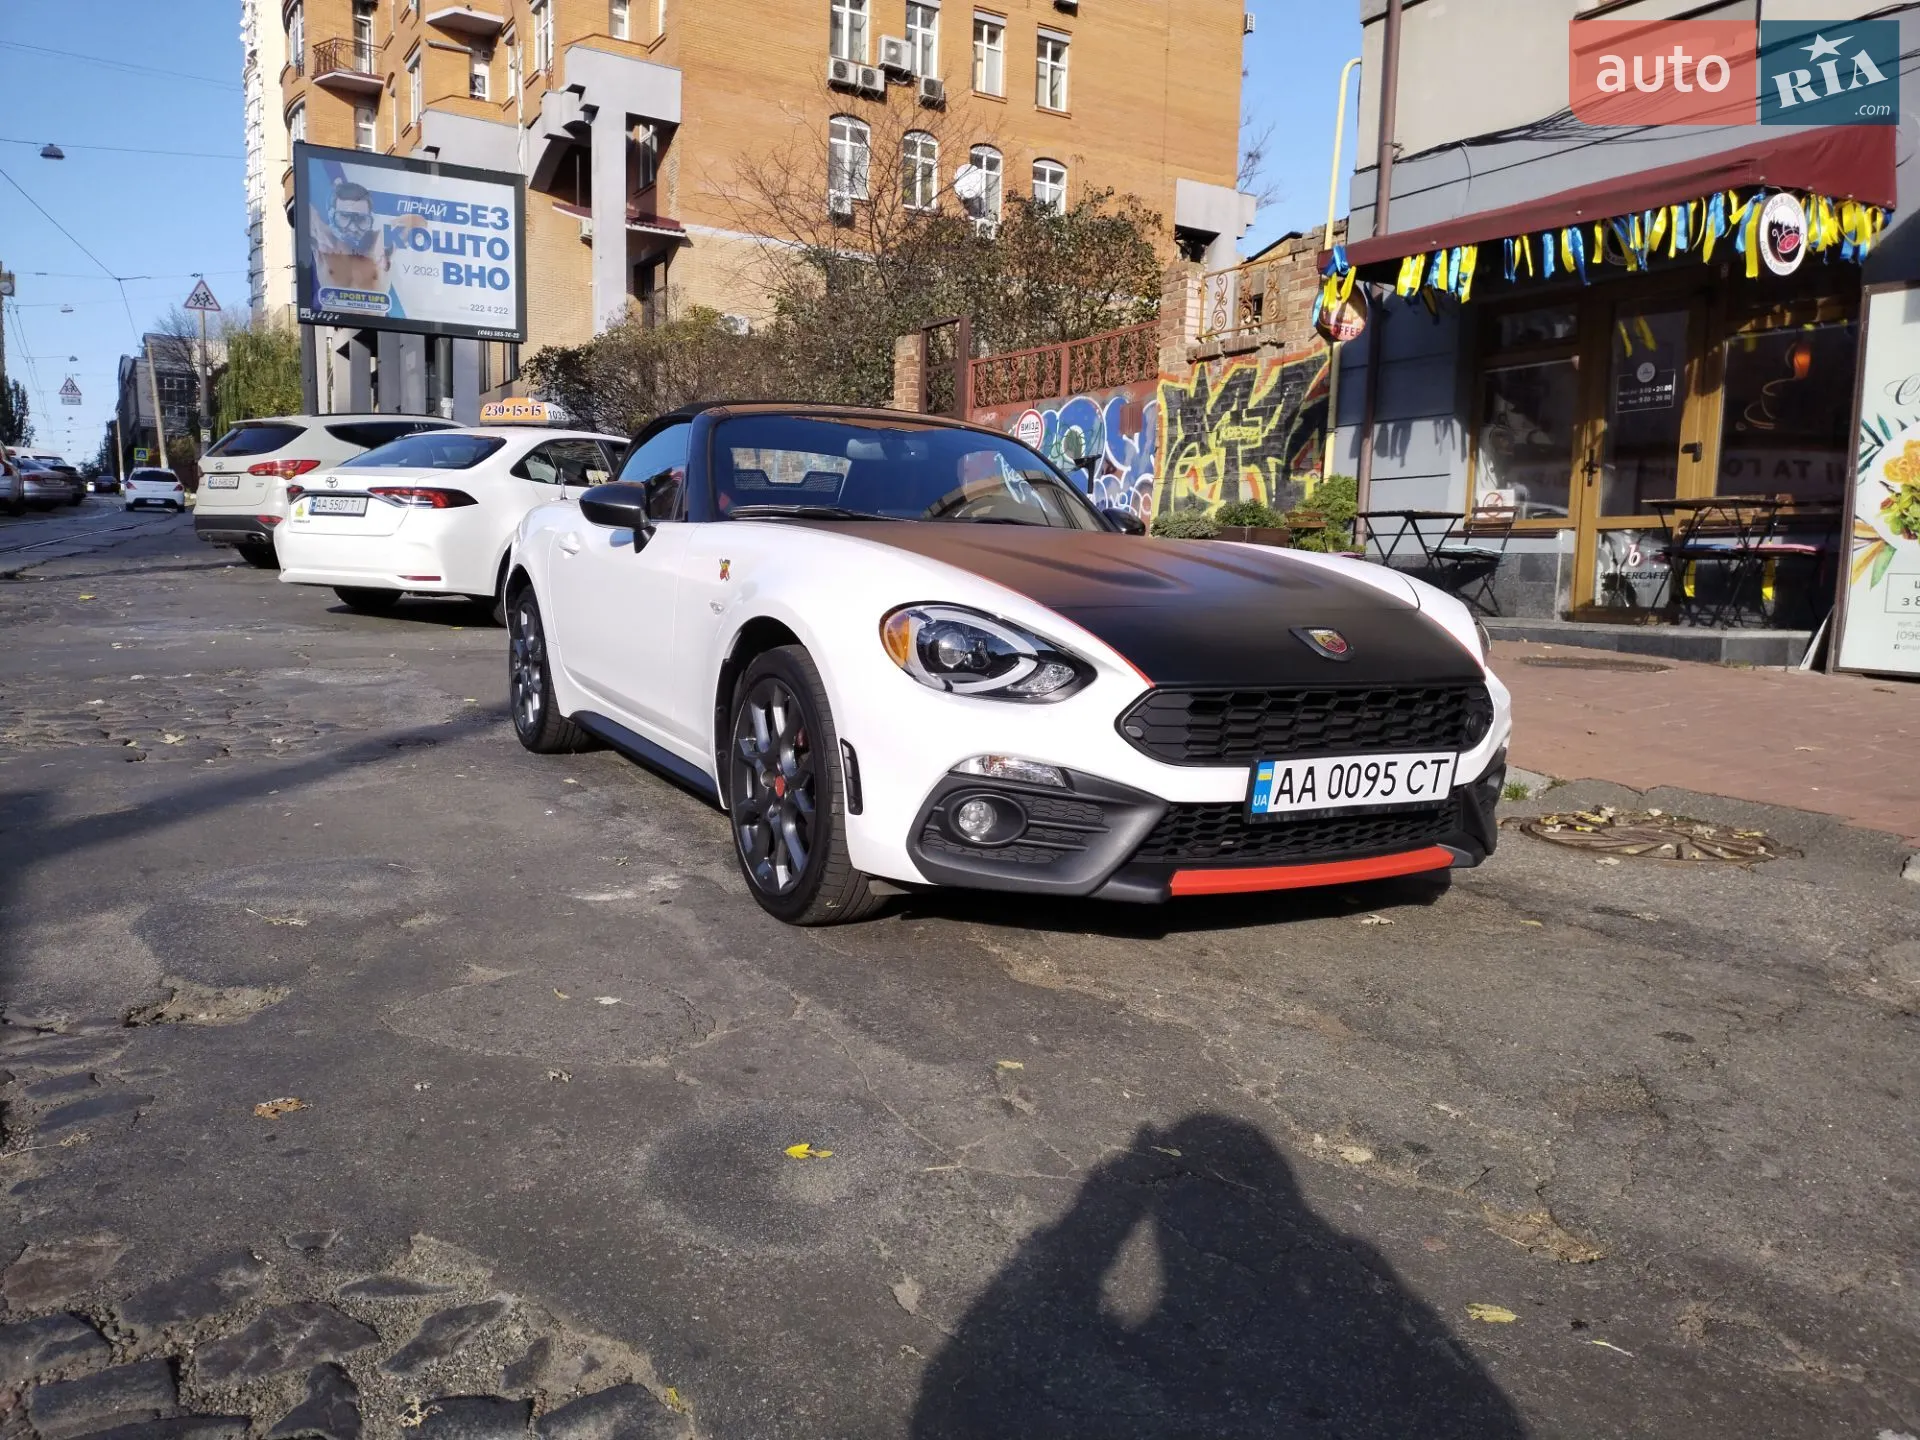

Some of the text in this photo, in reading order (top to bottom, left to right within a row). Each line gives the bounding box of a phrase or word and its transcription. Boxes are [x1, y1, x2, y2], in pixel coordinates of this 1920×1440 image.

[396, 198, 510, 231] ПІРНАЙ БЕЗ
[383, 224, 510, 261] КОШТО
[412, 265, 440, 277] 2023
[443, 262, 510, 291] ВНО
[470, 304, 485, 312] 222
[493, 306, 509, 315] 222
[547, 410, 568, 421] 1035
[316, 498, 328, 510] AA
[328, 499, 349, 511] 5507
[1600, 571, 1668, 580] BERCAFE
[1274, 758, 1450, 805] AA 0095 CT
[1253, 794, 1268, 806] UA
